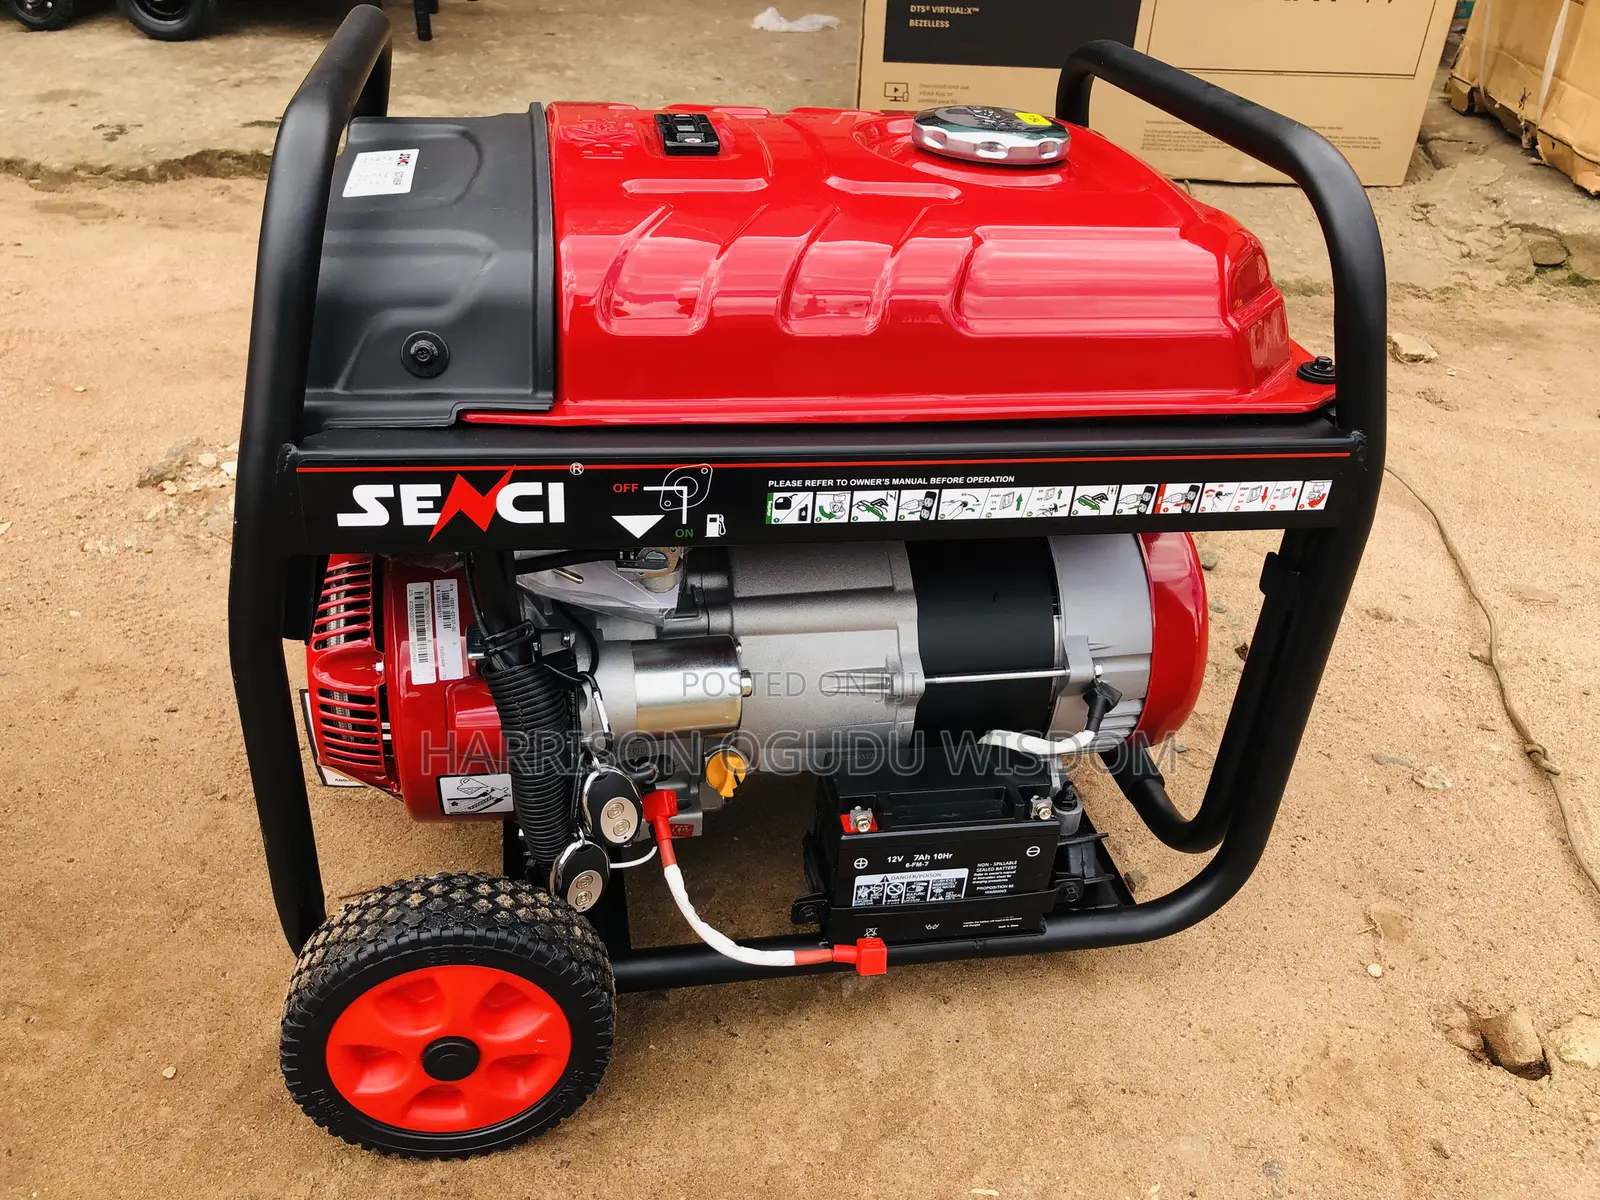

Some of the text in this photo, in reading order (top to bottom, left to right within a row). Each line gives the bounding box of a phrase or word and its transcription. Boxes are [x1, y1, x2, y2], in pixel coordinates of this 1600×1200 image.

[909, 19, 950, 28] BEZELLESS
[768, 475, 1015, 488] PLEASE REFER TO OWNER'S MANUAL BEFORE OPERATION
[612, 483, 640, 493] OFF
[675, 529, 694, 538] ON
[887, 855, 904, 863] 12V
[933, 852, 953, 860] 10Hr
[890, 872, 942, 880] DANGER/POISON
